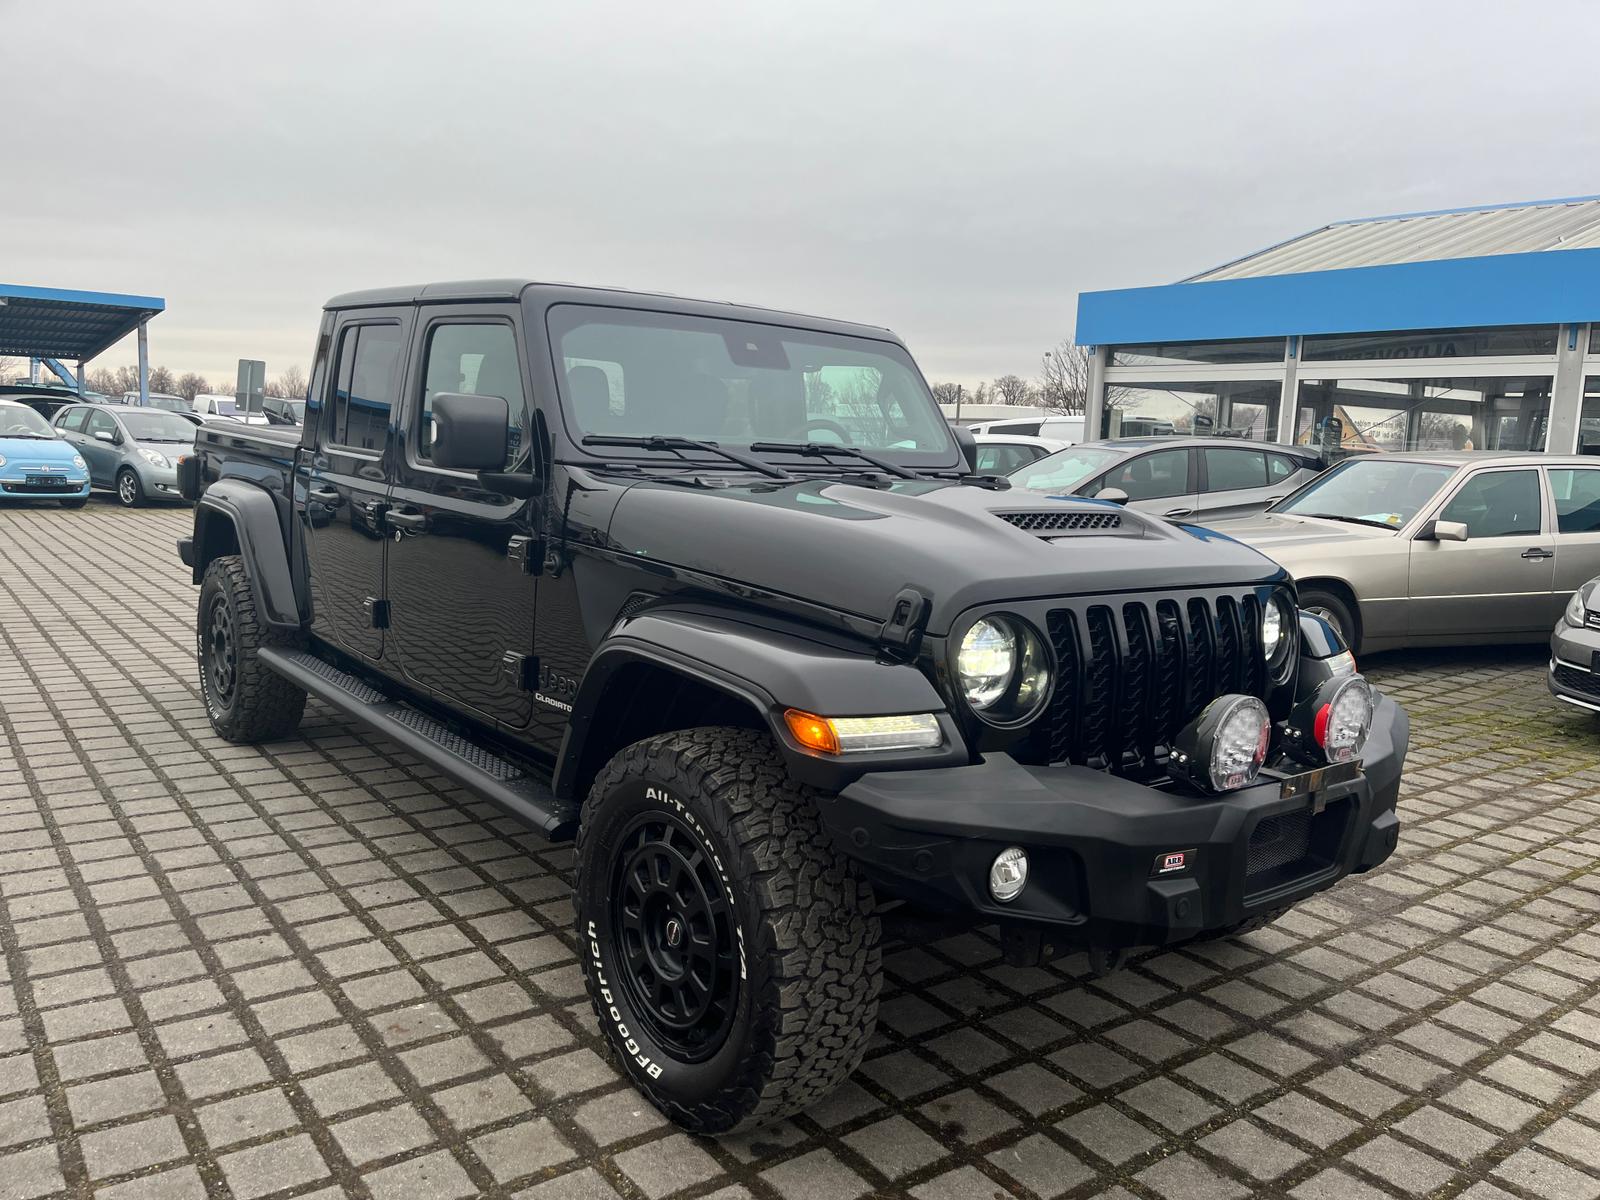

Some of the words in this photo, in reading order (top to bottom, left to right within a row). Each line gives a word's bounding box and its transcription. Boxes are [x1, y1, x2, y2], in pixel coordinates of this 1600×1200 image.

[535, 692, 573, 713] GLADIATO
[645, 787, 735, 905] All-Terrain
[736, 925, 747, 980] T/A
[1166, 856, 1183, 866] ARB
[588, 921, 663, 1079] BFGoodrich
